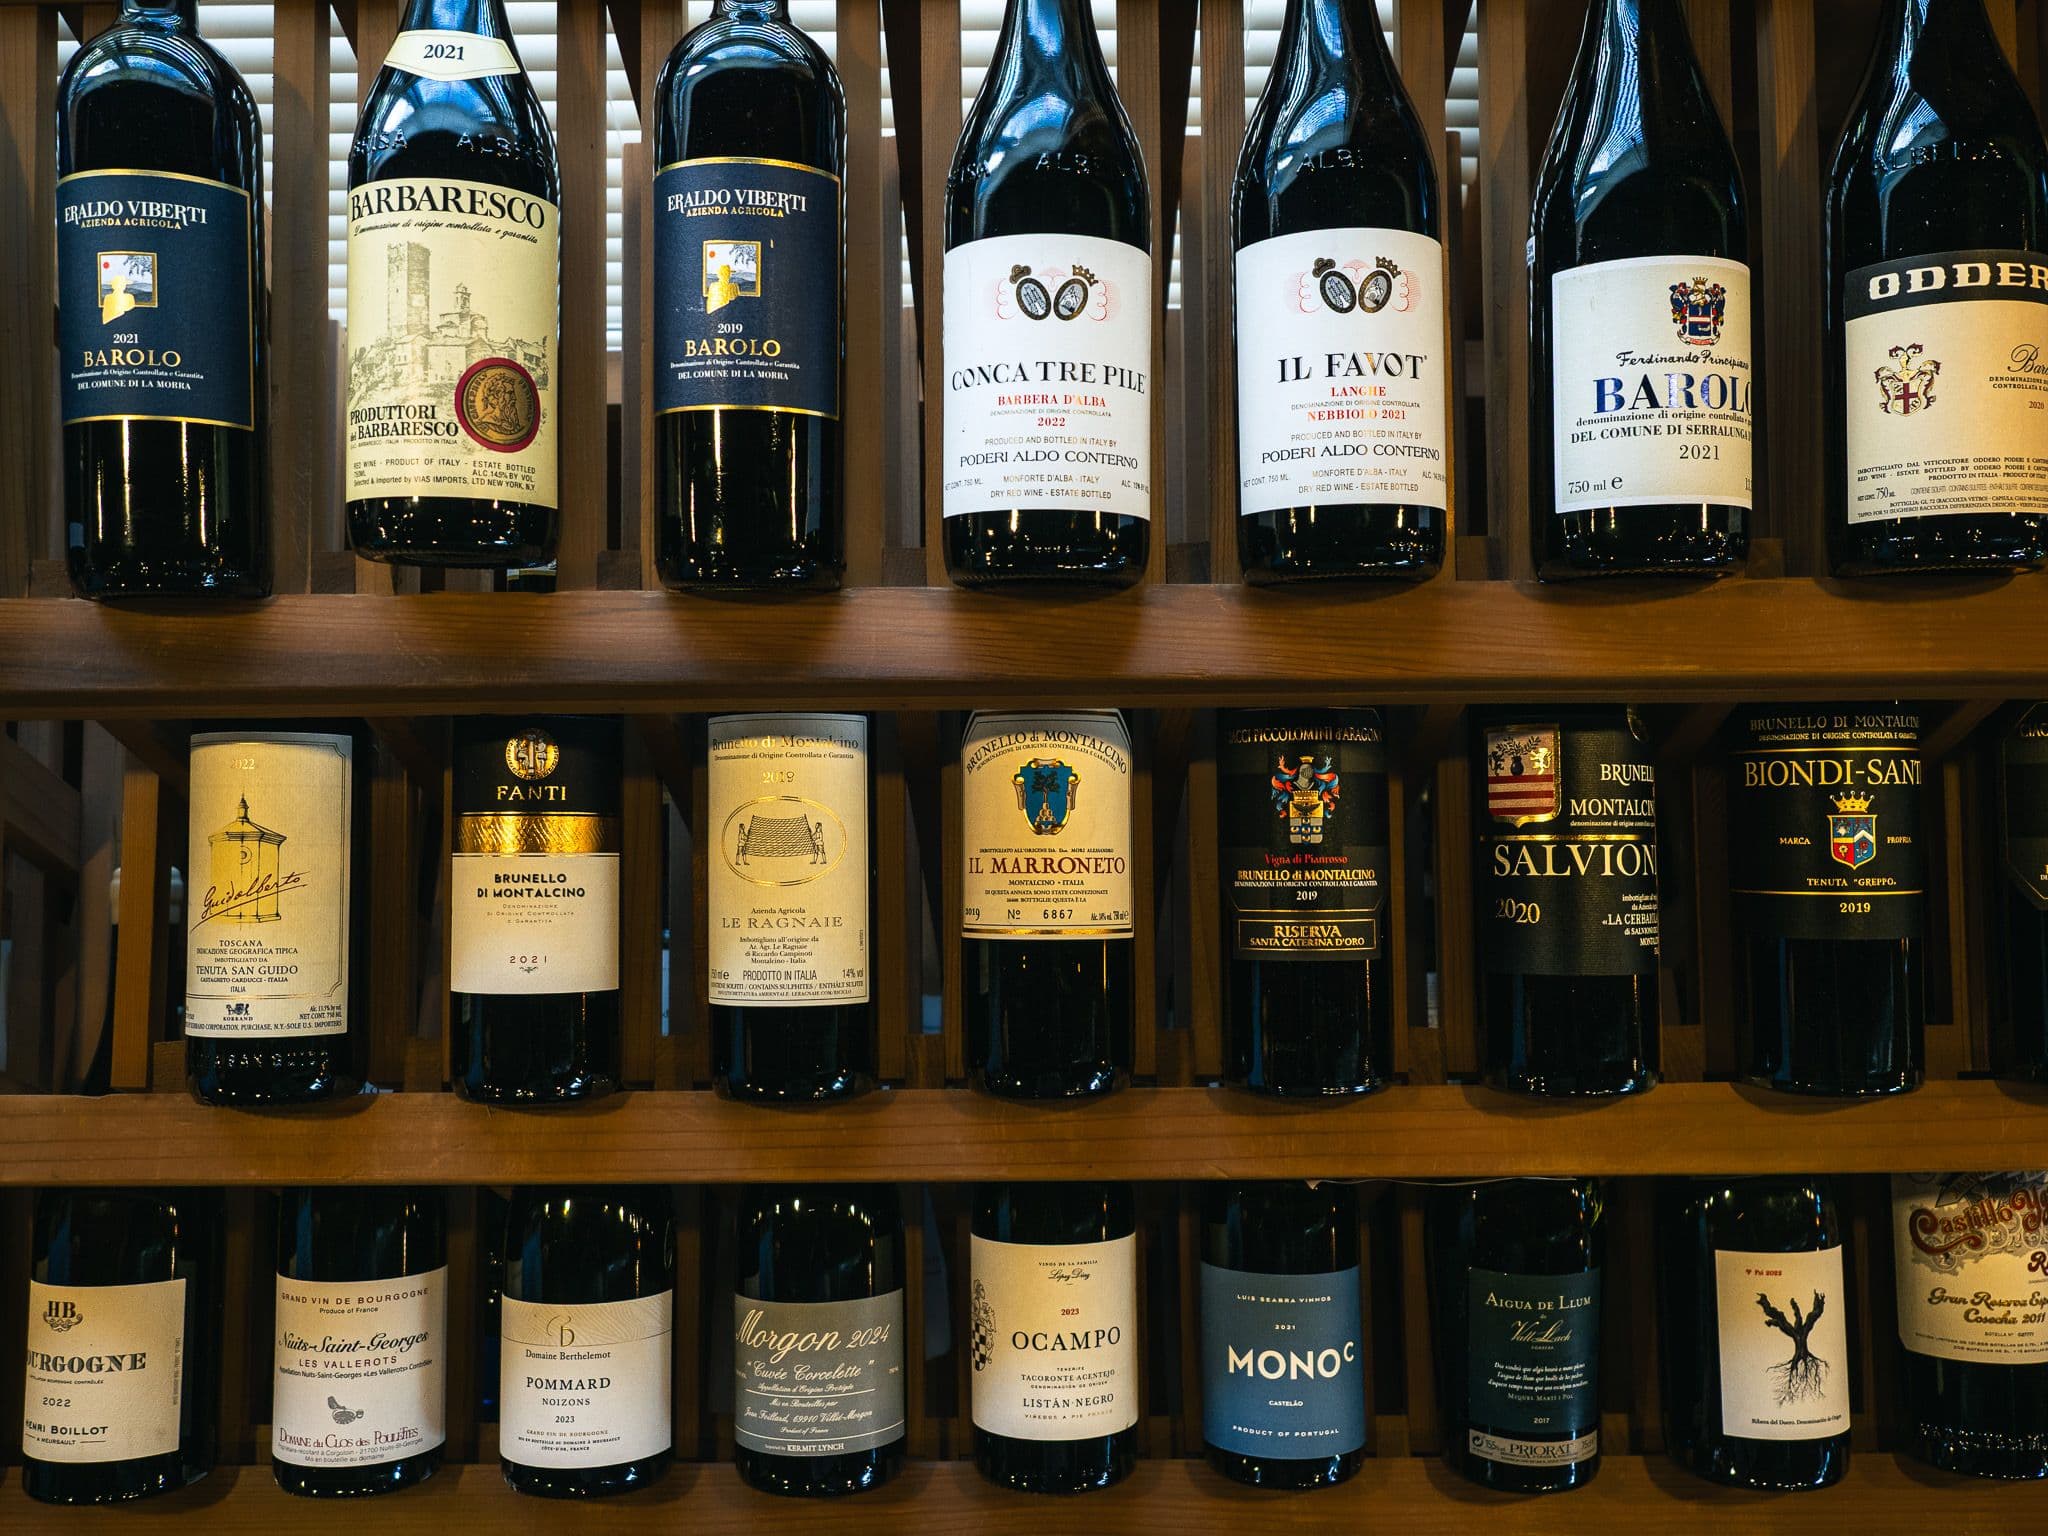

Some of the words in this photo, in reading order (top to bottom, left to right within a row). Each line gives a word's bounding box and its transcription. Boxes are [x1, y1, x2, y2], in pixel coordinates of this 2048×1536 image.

[423, 44, 465, 60] 2021
[351, 186, 545, 230] BARBARESCO
[668, 189, 730, 213] ERALDO
[734, 189, 807, 214] VIBERTI
[65, 200, 124, 225] ERALDO
[128, 201, 208, 226] VIBERTI
[686, 207, 728, 217] AZIENDA
[731, 207, 784, 217] AGRICOLA
[81, 218, 121, 228] AZIENDA
[124, 218, 181, 230] AGRICOLA
[1869, 262, 2048, 300] ODDER
[718, 323, 743, 333] 2019
[113, 334, 139, 344] 2021
[685, 339, 781, 357] BAROLO
[84, 349, 181, 368] BAROLO
[1616, 351, 1700, 367] Ferdinando
[693, 370, 728, 378] COMUNE
[1278, 356, 1312, 383] IL
[952, 362, 1030, 391] CONCA
[1036, 362, 1096, 383] TRE
[91, 379, 126, 389] COMUNE
[128, 379, 139, 387] DI
[142, 380, 154, 388] LA
[157, 380, 191, 390] MORRA
[1332, 387, 1386, 396] LANGHE
[998, 395, 1058, 406] BARBERA
[1064, 395, 1106, 407] D'ALBA
[2029, 401, 2044, 409] 2020
[350, 405, 437, 425] PRODUTTORI
[1308, 410, 1377, 421] NEBBIOLO
[1382, 410, 1406, 420] 2021
[1576, 413, 1654, 427] denominazione
[1658, 411, 1668, 419] di
[1672, 411, 1706, 420] origine
[1037, 418, 1066, 427] 2022
[358, 422, 458, 438] BARBARESCO
[1571, 432, 1596, 443] DEL
[1601, 425, 1662, 439] COMUNE
[1667, 425, 1682, 435] DI
[1686, 425, 1747, 440] SERRALUNGA
[1262, 447, 1316, 463] PODERI
[1321, 445, 1368, 457] ALDO
[1373, 444, 1440, 460] CONTERNO
[1680, 445, 1720, 460] 2021
[960, 452, 1008, 467] PODERI
[1013, 451, 1060, 462] ALDO
[1065, 451, 1138, 469] CONTERNO
[1923, 458, 1969, 466] VITICOLTORE
[506, 463, 536, 474] BOTTLED
[1568, 480, 1590, 494] 750
[1255, 728, 1333, 742] PICCOLOMINI
[712, 736, 758, 751] Brunello
[781, 735, 858, 749] Montalcino
[966, 731, 1027, 775] BRUNELLO
[1043, 730, 1127, 775] MONTALCINO
[497, 786, 567, 801] FANTI
[1780, 837, 1811, 845] MARCA
[969, 858, 983, 873] IL
[991, 857, 1125, 874] MARRONETO
[1265, 853, 1290, 867] Vigna
[1305, 853, 1348, 864] Pianrosso
[495, 874, 567, 884] BRUNELLO
[1304, 869, 1375, 880] MONTALCINO
[1807, 878, 1848, 887] TENUTA
[201, 871, 310, 921] Guidalberto
[477, 888, 488, 898] DI
[493, 888, 585, 898] MONTALCINO
[1296, 891, 1317, 901] 2019
[778, 908, 806, 916] Agricola
[1043, 909, 1073, 919] 6867
[1496, 898, 1541, 924] 2020
[1840, 902, 1871, 913] 2019
[722, 917, 741, 928] LE
[747, 917, 843, 928] RAGNAIE
[1273, 926, 1341, 938] RISERVA
[1250, 938, 1280, 946] SANTA
[1282, 938, 1333, 946] CATERINA
[1336, 938, 1364, 946] D'ORO
[510, 955, 547, 964] 2021
[196, 966, 229, 975] TENUTA
[231, 965, 255, 975] SAN
[258, 965, 298, 974] GUIDO
[743, 970, 781, 981] PRODOTTO
[794, 970, 817, 980] ITALIA
[1909, 1198, 2013, 1254] Castillo
[282, 1293, 307, 1303] GRAND
[358, 1288, 428, 1304] BOURGOGNE
[1928, 1287, 1968, 1305] Gran
[1970, 1292, 2027, 1310] Reserva
[47, 1301, 76, 1319] HB
[1538, 1302, 1553, 1310] DE
[1964, 1308, 2018, 1324] Cosecha
[2022, 1312, 2045, 1323] 2011
[279, 1330, 430, 1353] Nuits-Saint-Georges
[736, 1309, 841, 1364] Morgon
[846, 1324, 890, 1349] 2024
[1012, 1327, 1121, 1351] OCAMPO
[526, 1349, 557, 1360] Domaine
[560, 1351, 611, 1361] Berthelemot
[299, 1359, 317, 1368] LES
[324, 1355, 397, 1369] VALLEROTS
[1077, 1369, 1115, 1381] ACENTEJO
[526, 1377, 611, 1390] POMMARD
[42, 1397, 71, 1407] 2022
[542, 1398, 590, 1406] NOIZONS
[51, 1426, 108, 1435] BOILLOT
[1233, 1425, 1272, 1436] PRODUCT
[818, 1443, 844, 1451] LYNCH
[1510, 1443, 1572, 1458] PRIORAT
